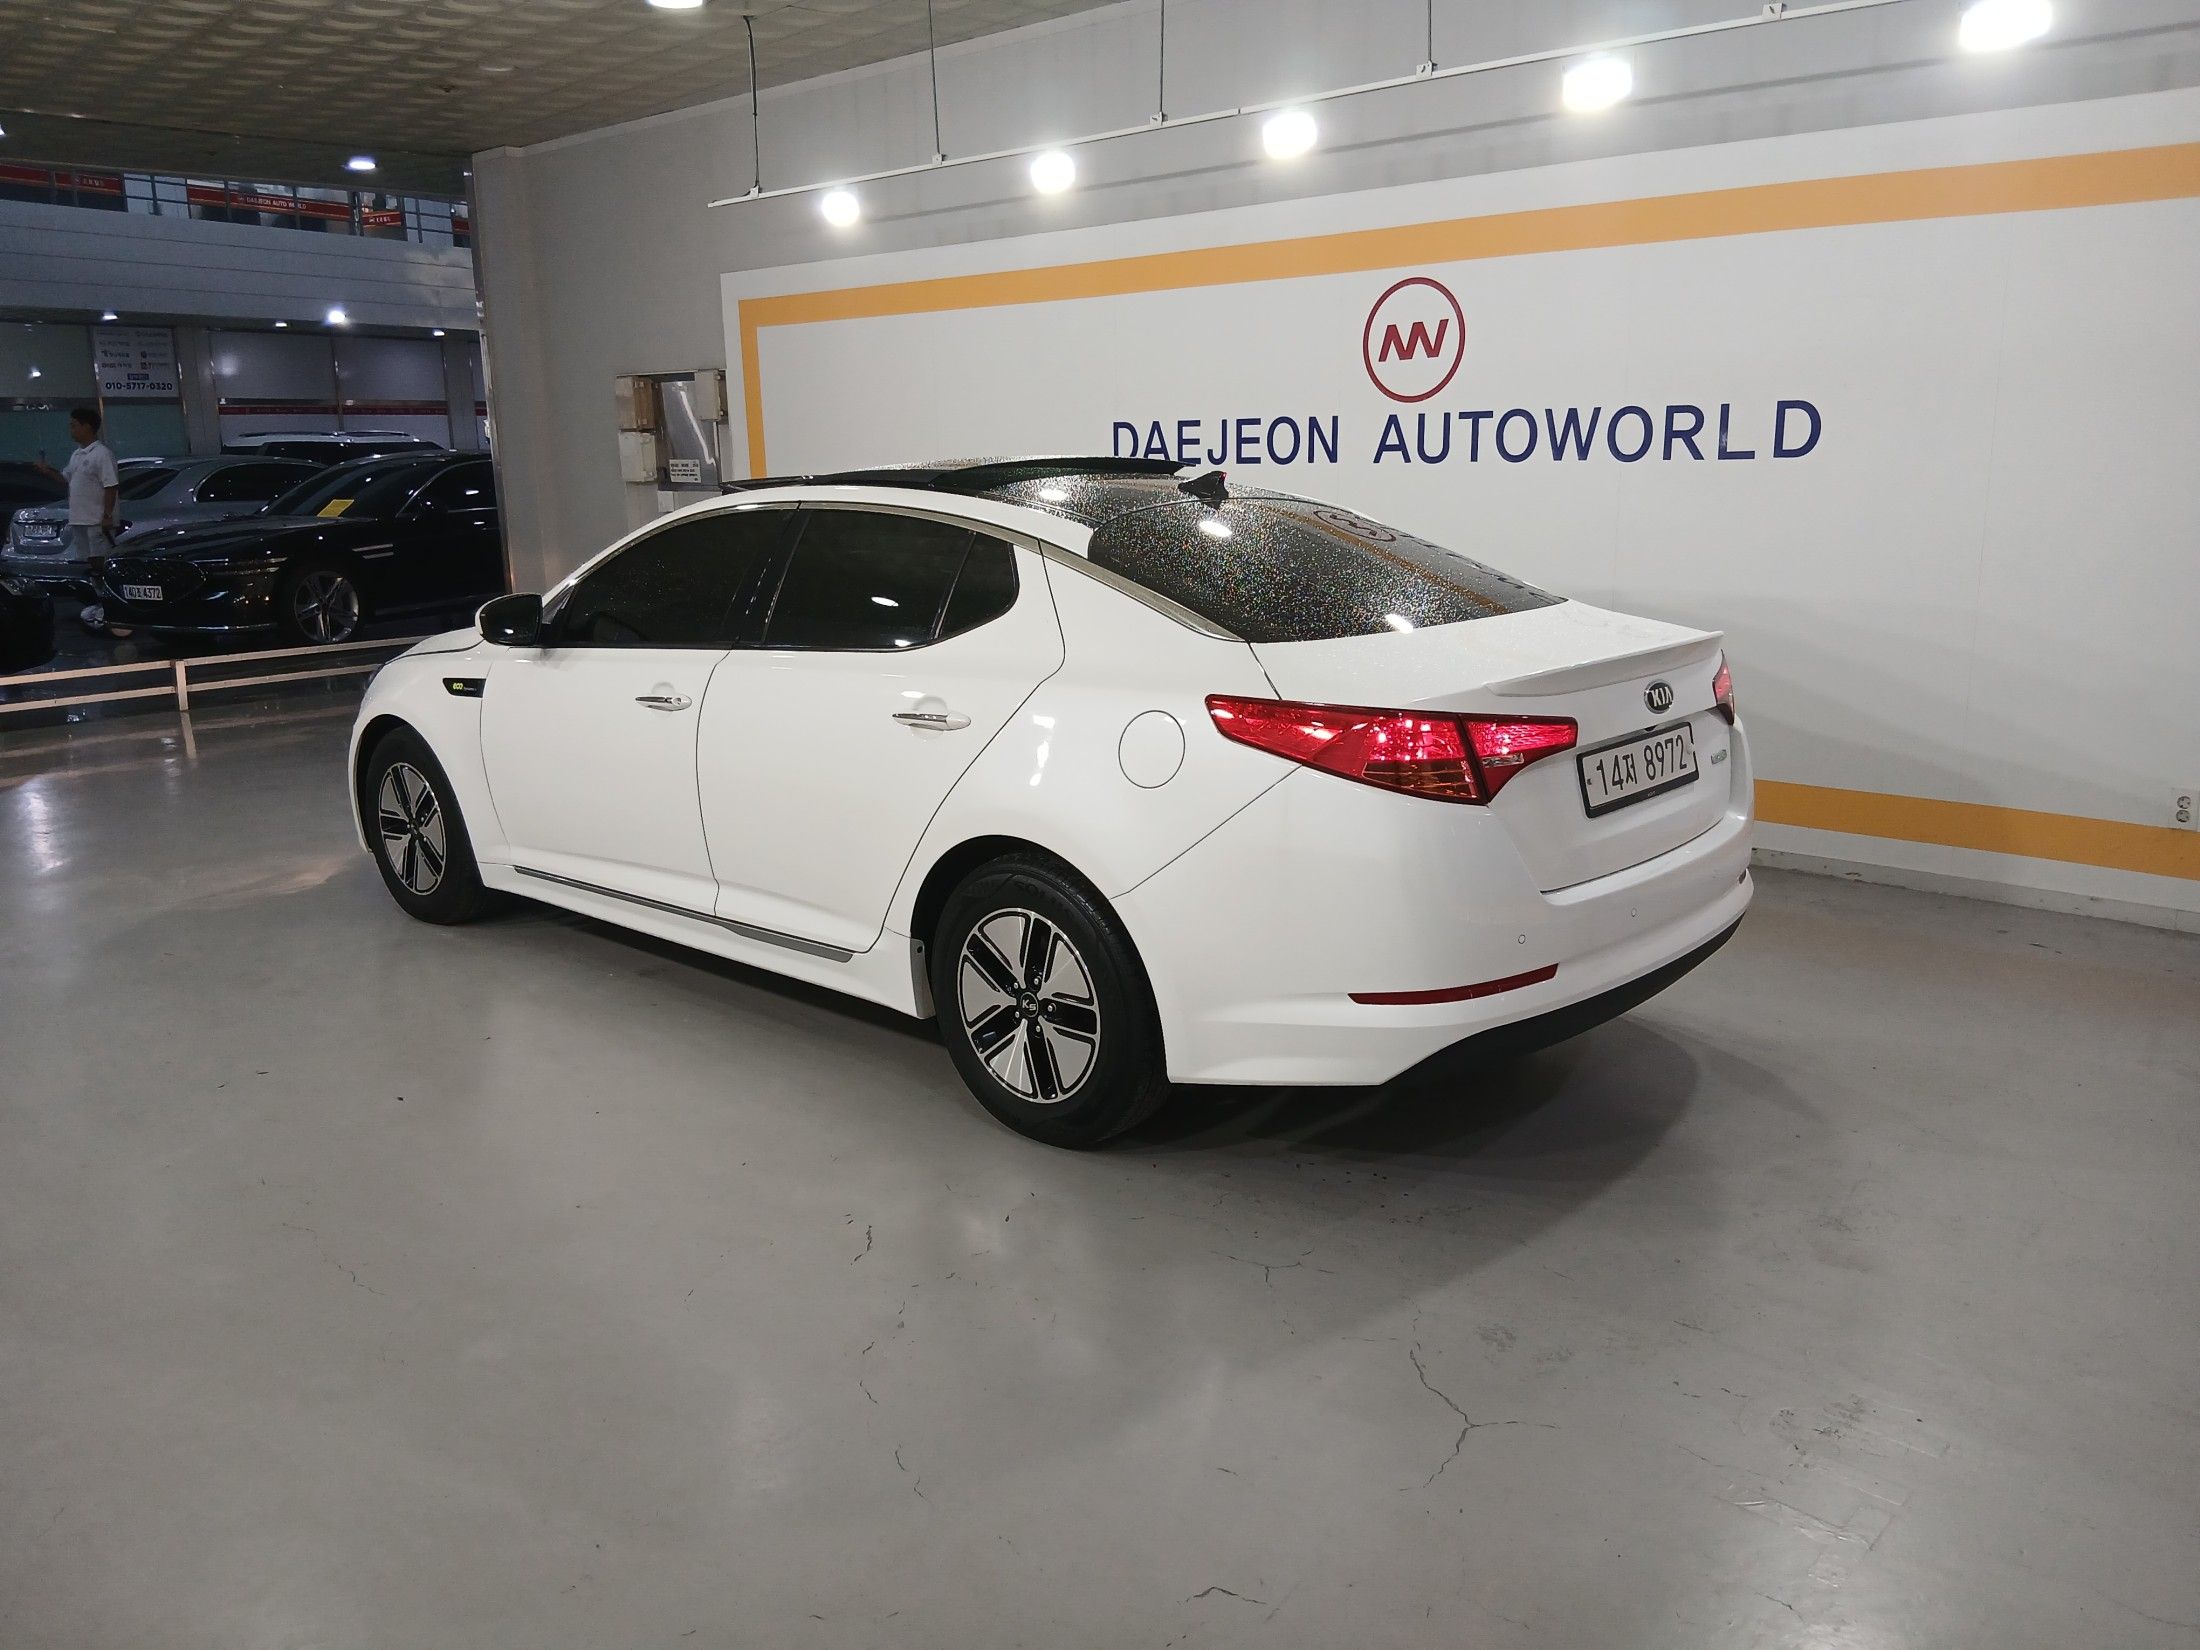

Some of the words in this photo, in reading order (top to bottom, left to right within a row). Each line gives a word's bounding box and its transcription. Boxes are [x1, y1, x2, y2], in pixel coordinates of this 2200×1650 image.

[1112, 416, 1339, 466] DAEJEON
[1372, 399, 1822, 464] AUTOWORLD
[1651, 685, 1673, 707] KIA
[1643, 734, 1688, 781] 8972
